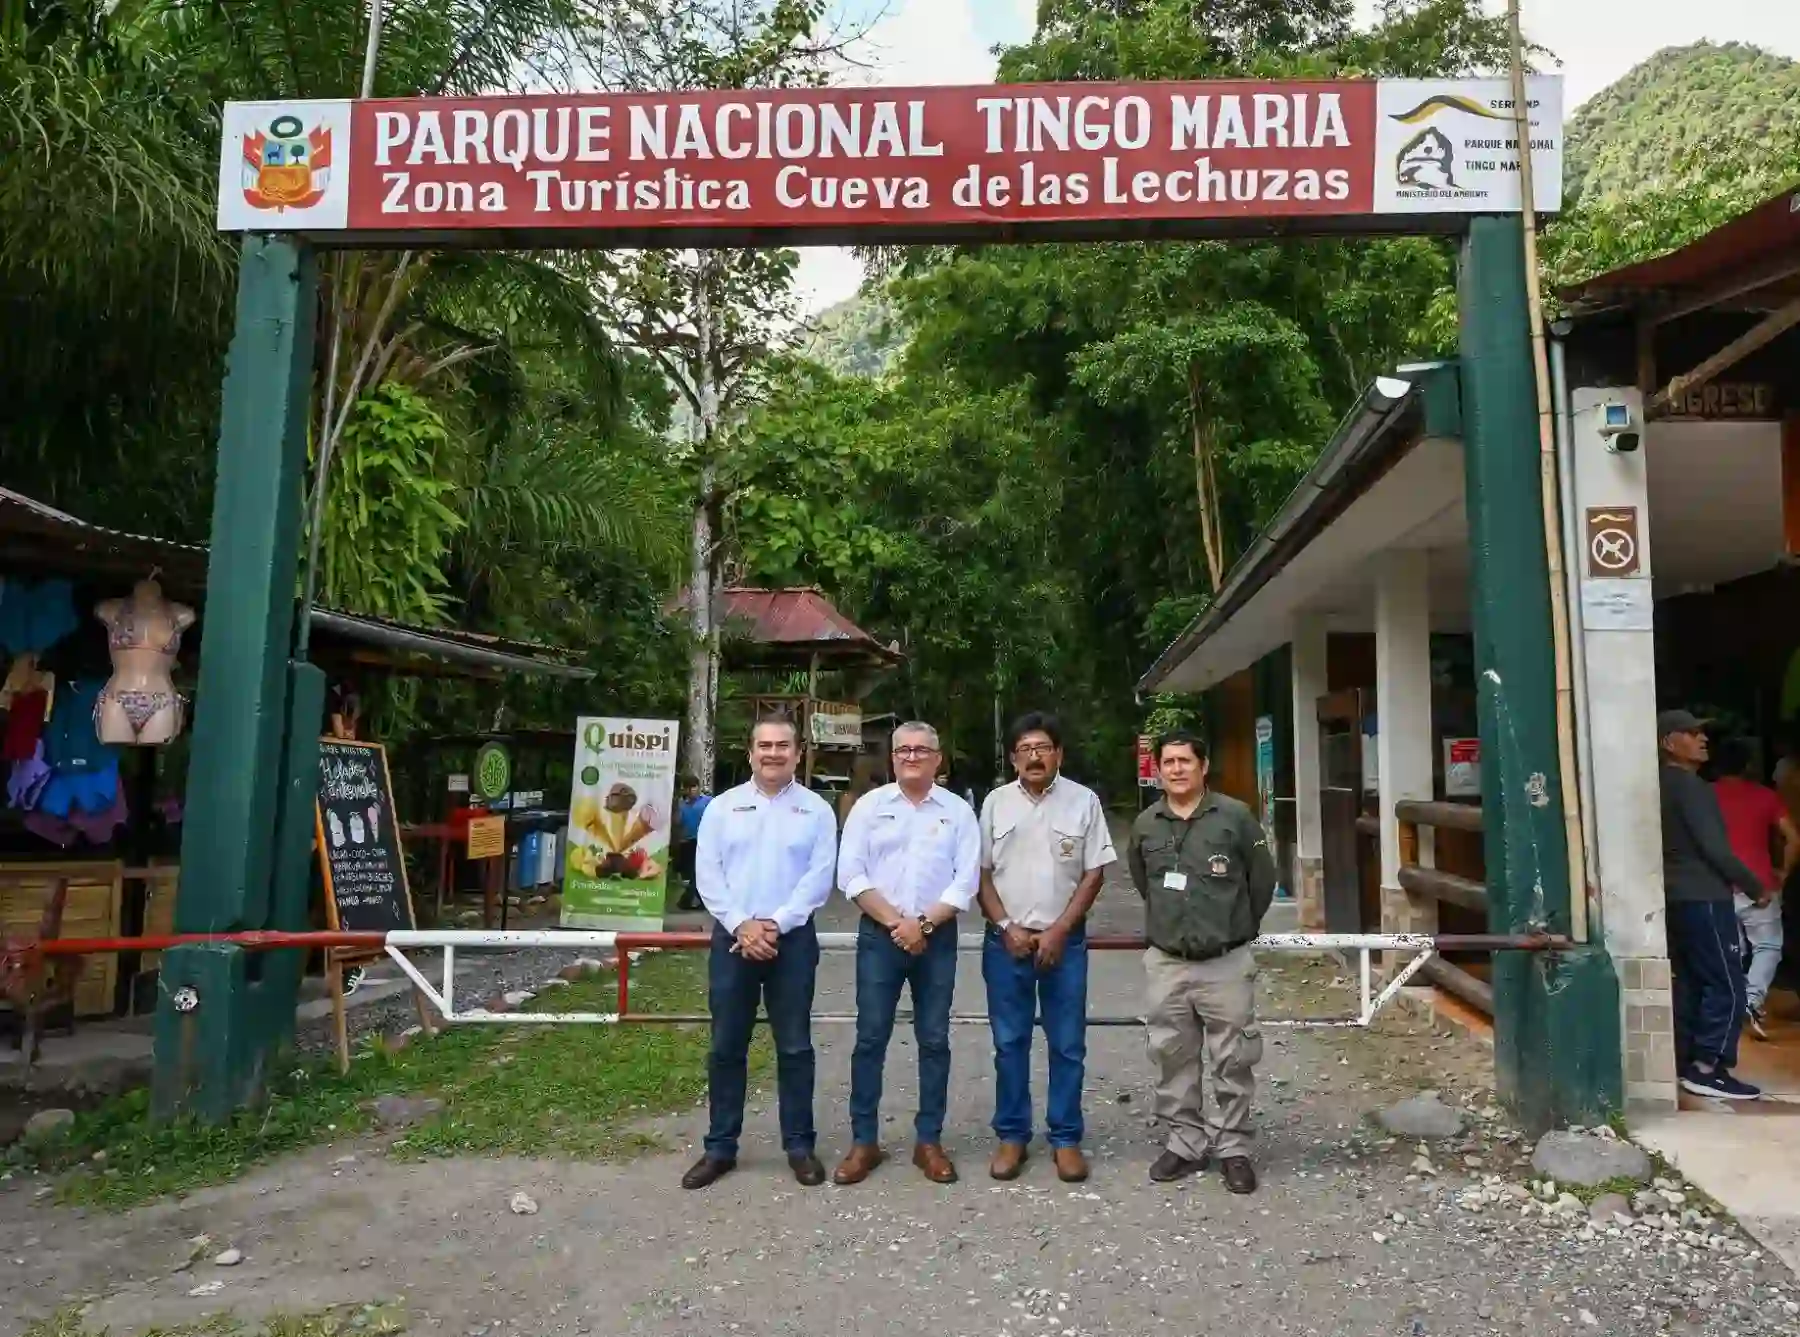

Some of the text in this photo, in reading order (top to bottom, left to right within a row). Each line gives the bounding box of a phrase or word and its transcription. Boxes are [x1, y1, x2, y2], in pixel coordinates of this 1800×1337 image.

[1490, 99, 1540, 109] SERNP
[374, 93, 1352, 172] PARQUE NACIONAL TINGO MARIA
[1464, 139, 1554, 150] PARQUE NAONAL
[1465, 160, 1496, 171] TINGO
[381, 156, 1351, 214] Zona Turística Cueva de las Lechuzas
[584, 722, 670, 756] Quispi
